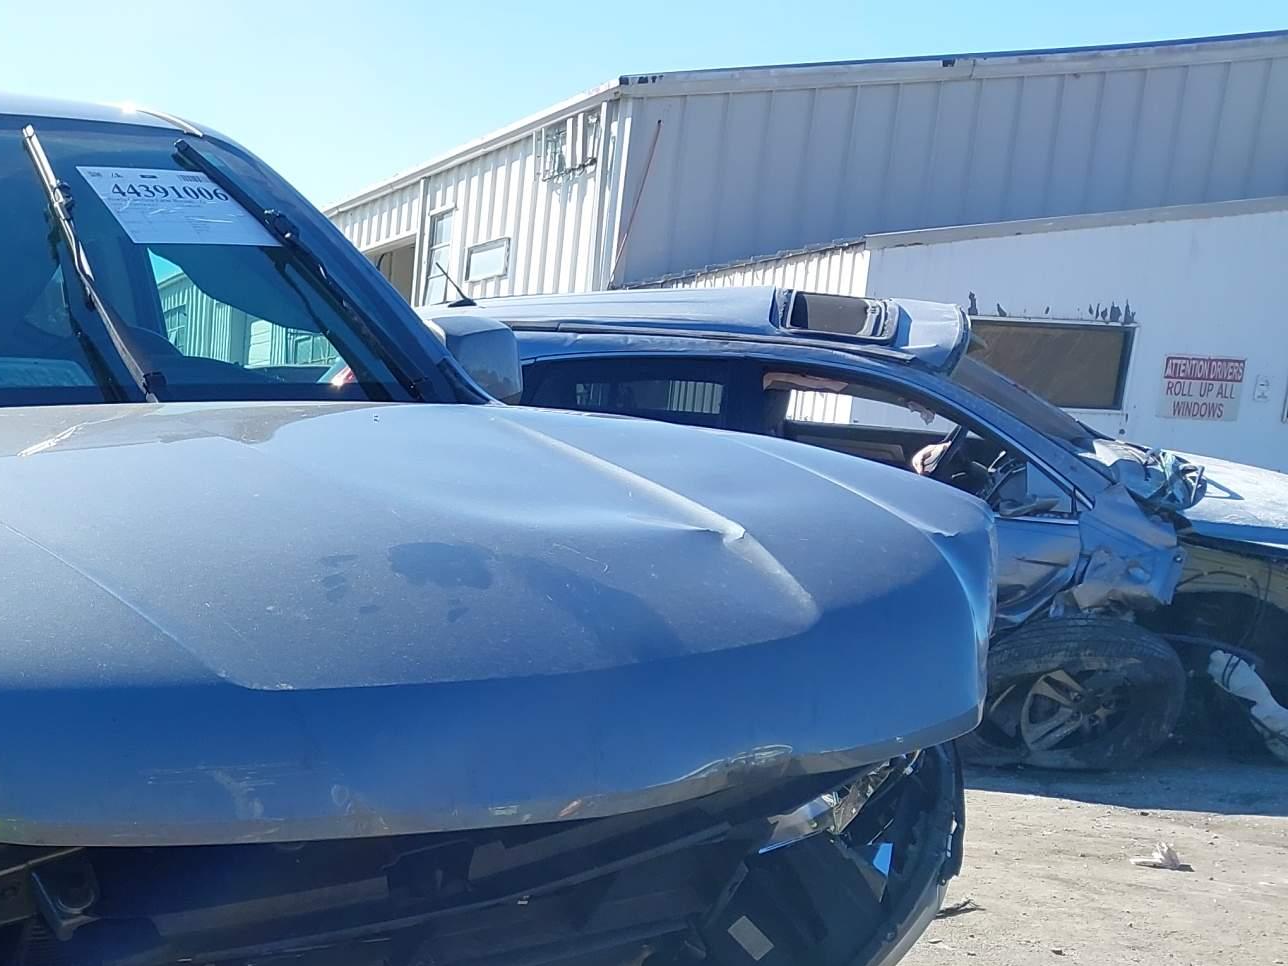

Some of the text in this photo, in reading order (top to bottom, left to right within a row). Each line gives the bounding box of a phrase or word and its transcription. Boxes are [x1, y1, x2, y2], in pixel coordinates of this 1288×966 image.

[112, 183, 229, 201] 44391006
[1165, 359, 1244, 380] ATTENTION DRIVERS
[1166, 381, 1236, 399] ROLL UP ALL
[1173, 401, 1224, 418] WINDOWS
